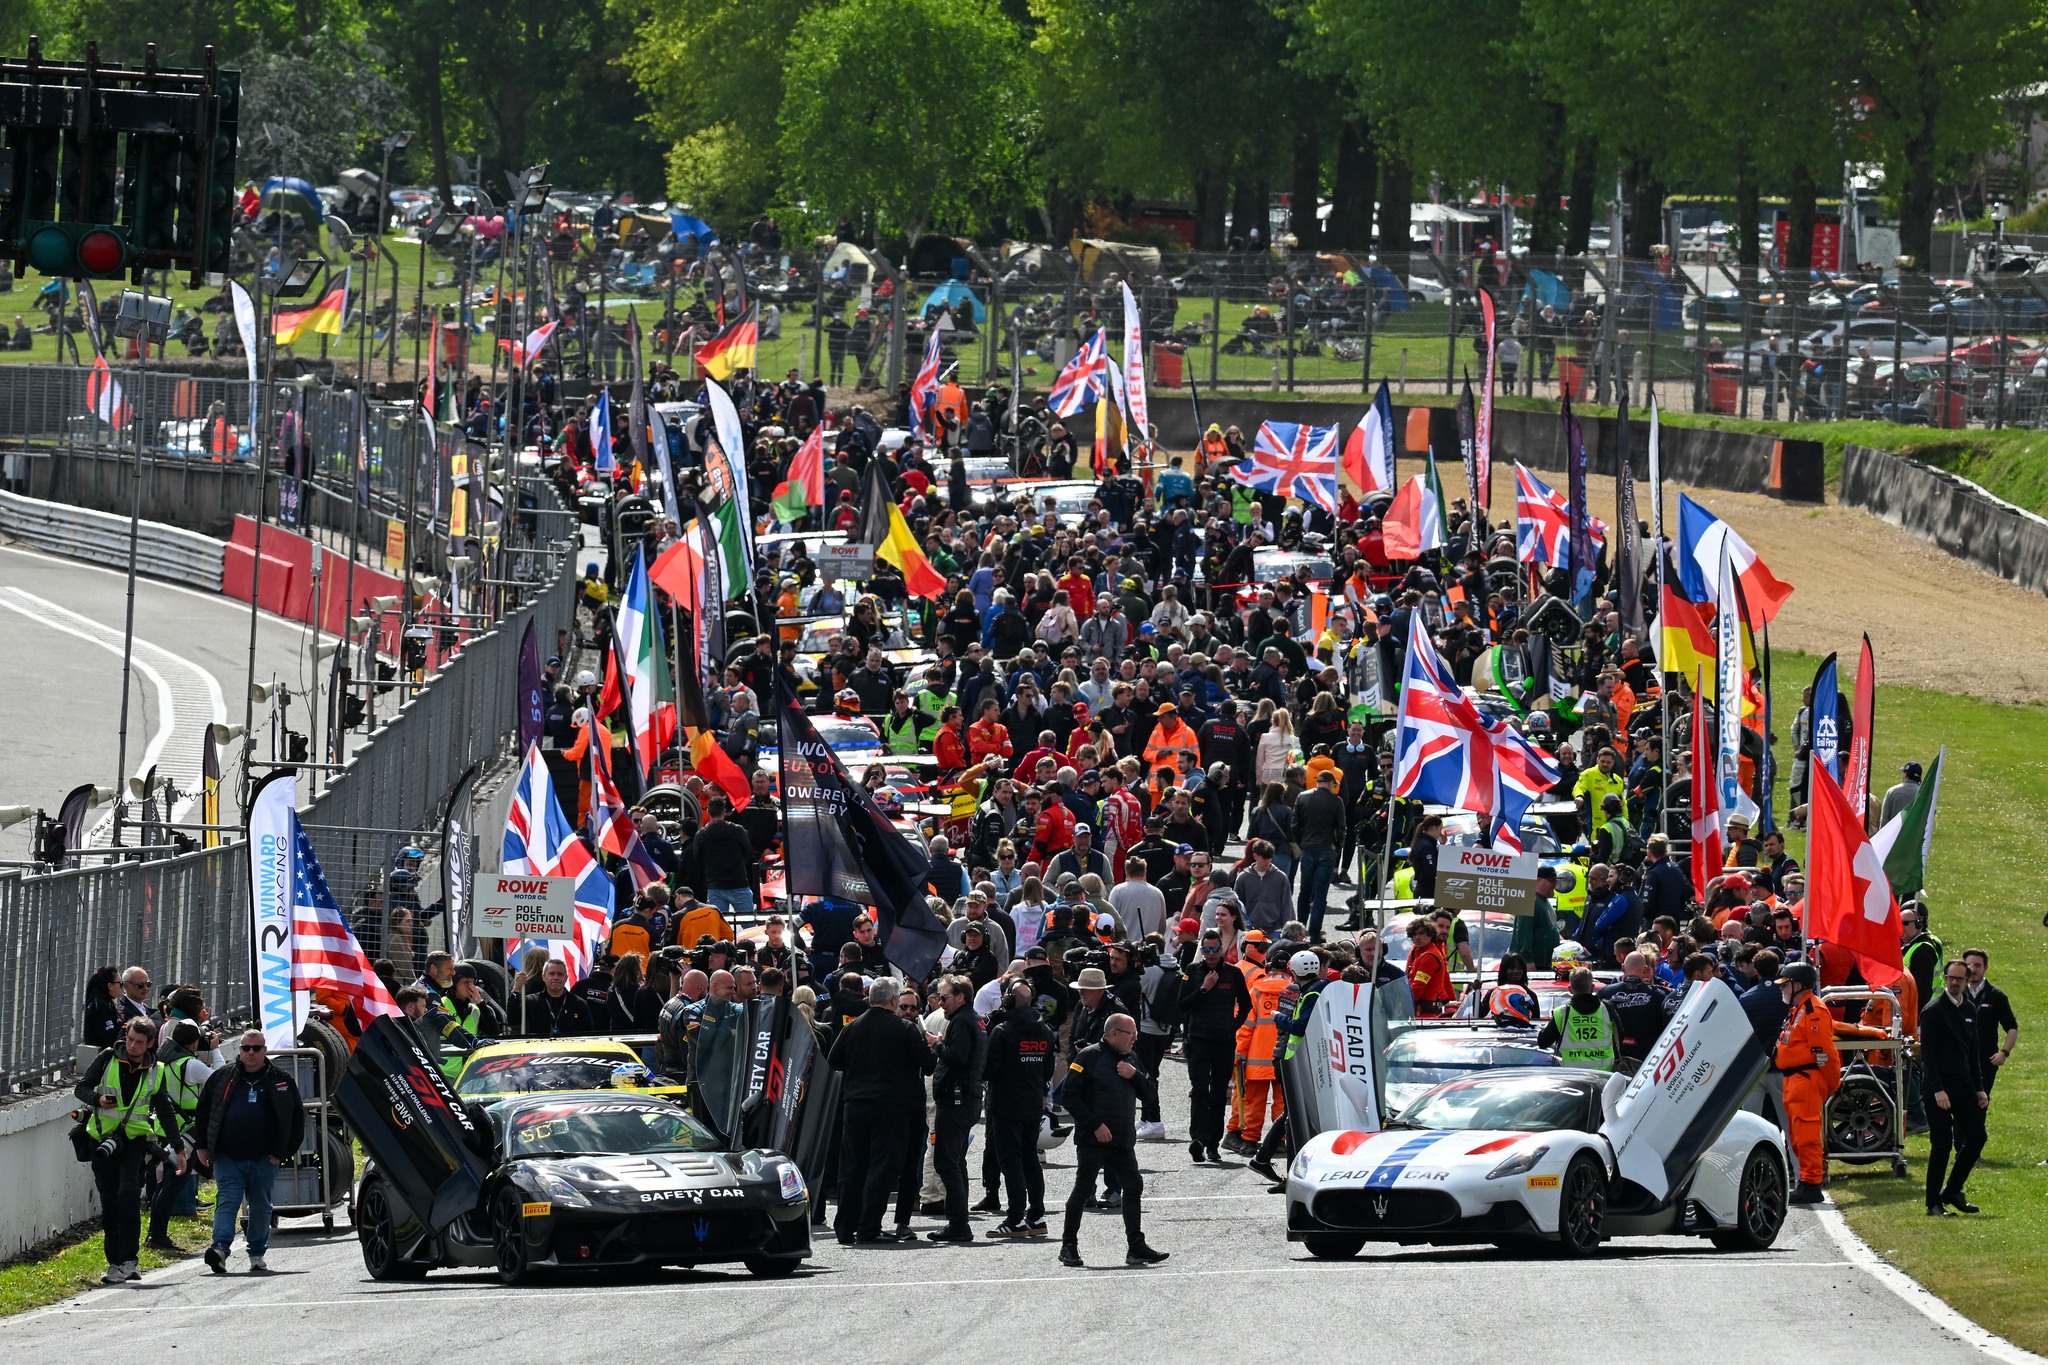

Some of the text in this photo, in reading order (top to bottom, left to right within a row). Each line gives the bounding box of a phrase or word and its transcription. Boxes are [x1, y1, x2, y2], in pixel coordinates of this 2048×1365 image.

[831, 547, 859, 555] ROWE
[1213, 725, 1236, 733] SRO
[661, 775, 678, 785] 51
[828, 804, 848, 816] BY
[1460, 851, 1512, 868] ROWE
[260, 833, 276, 919] WINWARD
[276, 836, 288, 918] RACING
[1476, 866, 1498, 874] MOTOR
[497, 879, 549, 894] ROWE
[1445, 878, 1474, 886] GT
[1478, 877, 1504, 887] POLE
[1477, 886, 1526, 898] POSITION
[1476, 895, 1505, 907] GOLD
[516, 905, 542, 914] POLE
[516, 914, 564, 923] POSITION
[515, 923, 566, 934] OVERALL
[1345, 1015, 1364, 1058] LEAD
[1575, 1027, 1598, 1040] 152
[1019, 1040, 1048, 1051] SRO
[1626, 1053, 1660, 1100] LEAD
[1659, 1013, 1689, 1049] CAR
[1653, 1024, 1689, 1086] GT
[476, 1054, 550, 1075] GT
[749, 1031, 771, 1097] FETY CAR
[1666, 1040, 1702, 1091] WORLD CHALLENGE
[1691, 1060, 1710, 1084] aws
[383, 1078, 400, 1101] POWERED
[389, 1073, 406, 1096] EUROPE
[409, 1065, 453, 1118] GT
[412, 1046, 475, 1131] SAFETY CAR
[792, 1076, 802, 1099] aws
[1669, 1077, 1685, 1099] EUROPE
[389, 1096, 395, 1104] BY
[397, 1074, 433, 1125] WORLD CHALLENGE
[1675, 1081, 1691, 1104] POWERED
[395, 1101, 414, 1126] aws
[576, 1105, 687, 1117] WORLD
[521, 1124, 551, 1143] SC
[1319, 1170, 1449, 1182] LEAD CAR
[1530, 1178, 1558, 1187] PIRELLI
[640, 1189, 745, 1203] SAFETY CAR
[524, 1205, 549, 1216] PIRELLI
